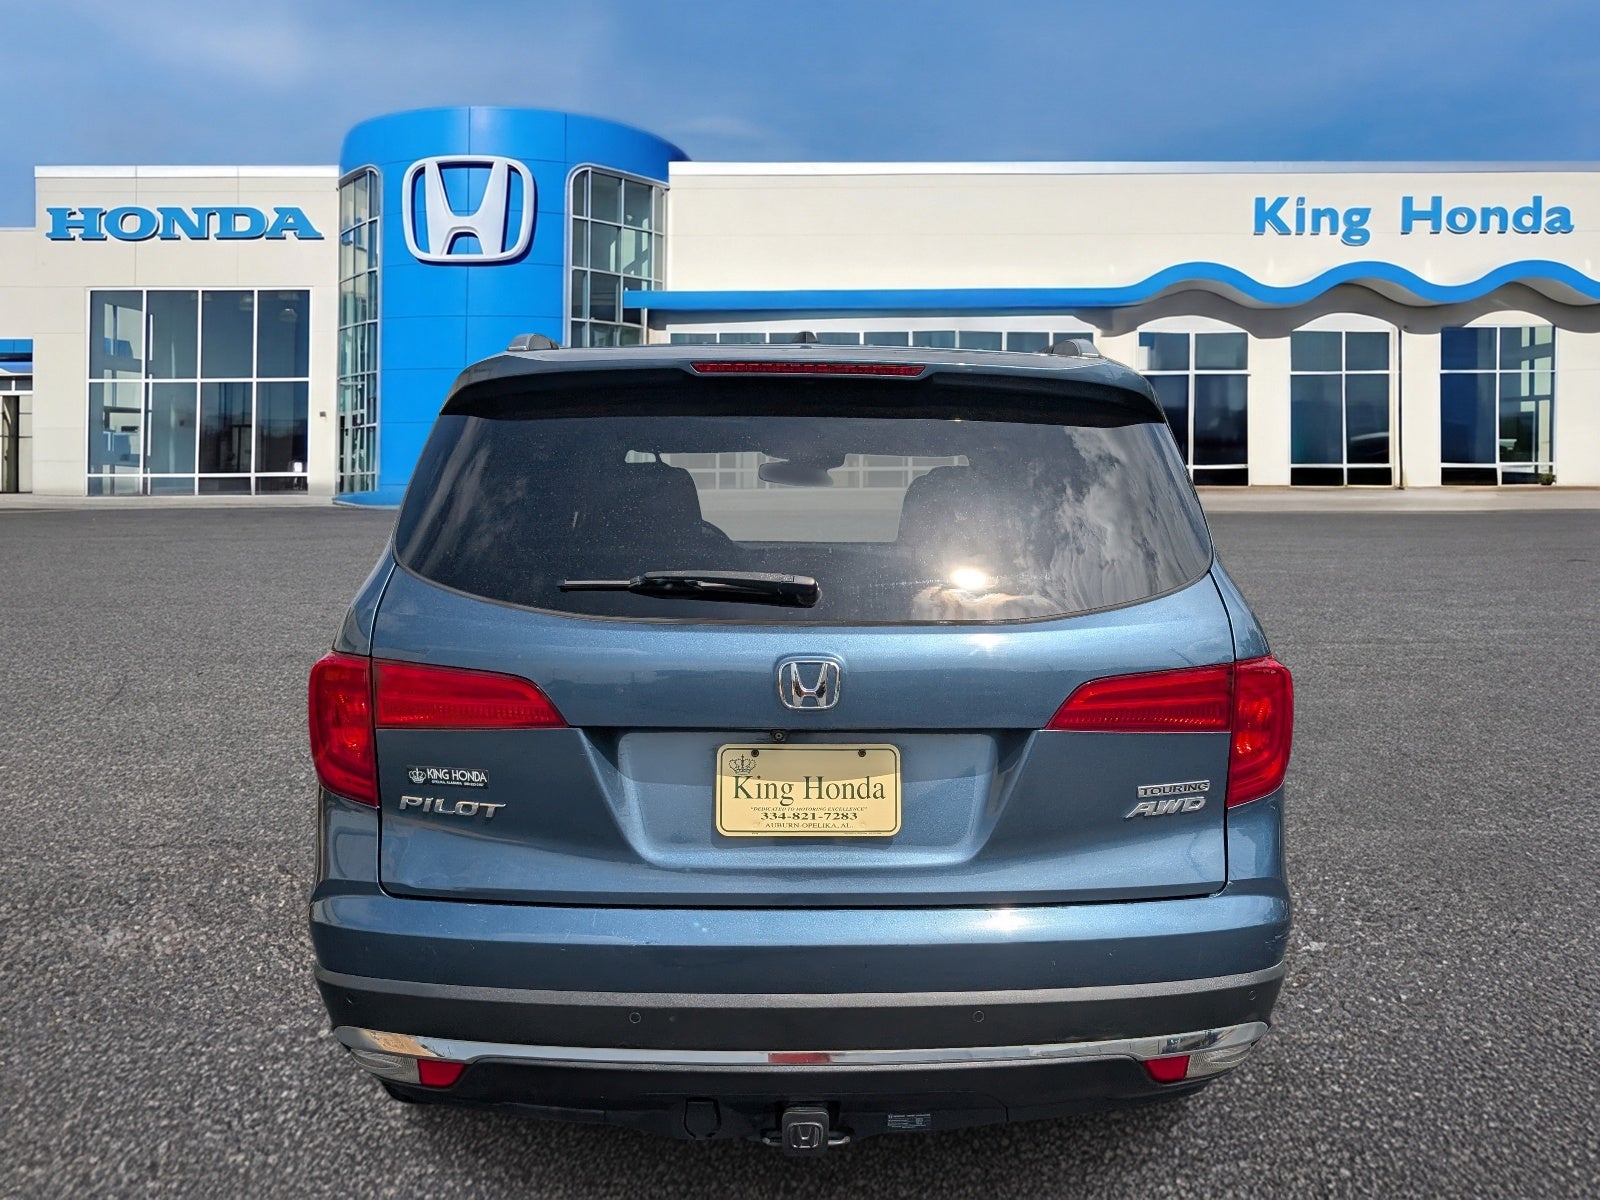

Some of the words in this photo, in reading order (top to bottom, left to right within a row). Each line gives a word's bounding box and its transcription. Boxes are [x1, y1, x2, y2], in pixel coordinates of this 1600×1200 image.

[46, 206, 324, 241] HONDA
[1254, 196, 1372, 246] King
[1400, 195, 1575, 234] Honda
[427, 768, 449, 780] KING
[452, 769, 487, 782] HONDA
[733, 775, 794, 806] King
[803, 775, 886, 800] Honda
[1140, 782, 1209, 796] TOURING
[399, 796, 506, 817] PILOT
[760, 812, 858, 820] 334-821-7283
[1125, 797, 1206, 818] AWD
